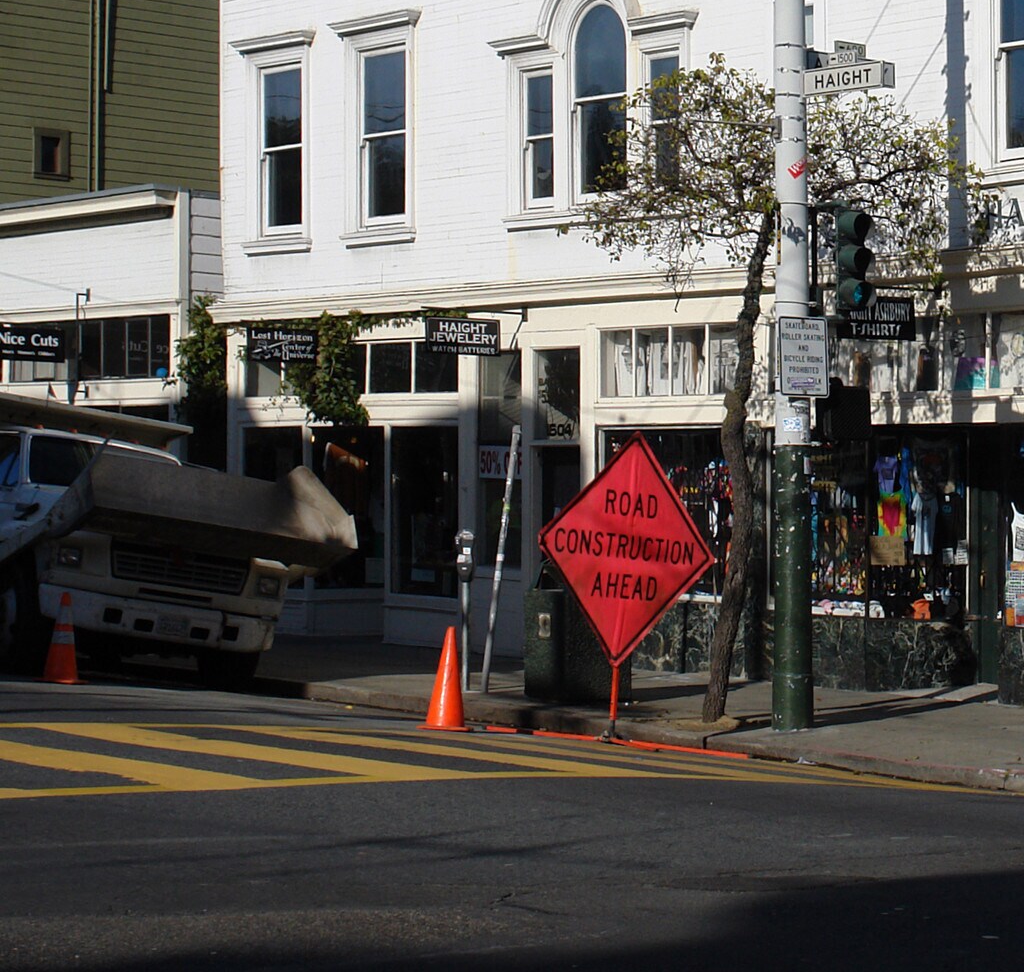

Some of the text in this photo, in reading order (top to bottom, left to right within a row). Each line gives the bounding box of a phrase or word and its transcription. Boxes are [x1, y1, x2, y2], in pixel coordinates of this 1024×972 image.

[837, 53, 853, 63] 1500
[815, 68, 872, 89] HAIGHT
[875, 302, 911, 322] ASHBURY
[440, 321, 487, 334] HAIGHT
[850, 323, 902, 337] T-SHIRTS
[0, 331, 59, 347] Nice Cuts
[430, 332, 497, 345] JEWELERY
[782, 333, 825, 342] ROLLER SKATING
[432, 345, 496, 355] WATCH BATTERIES
[798, 344, 809, 352] AND
[784, 355, 824, 364] BICYCLE RIDING
[789, 366, 820, 375] PROHIBITED
[480, 450, 522, 475] 50% OF
[604, 489, 658, 519] ROAD
[554, 527, 694, 566] CONSTRUCTION
[590, 572, 658, 601] AHEAD
